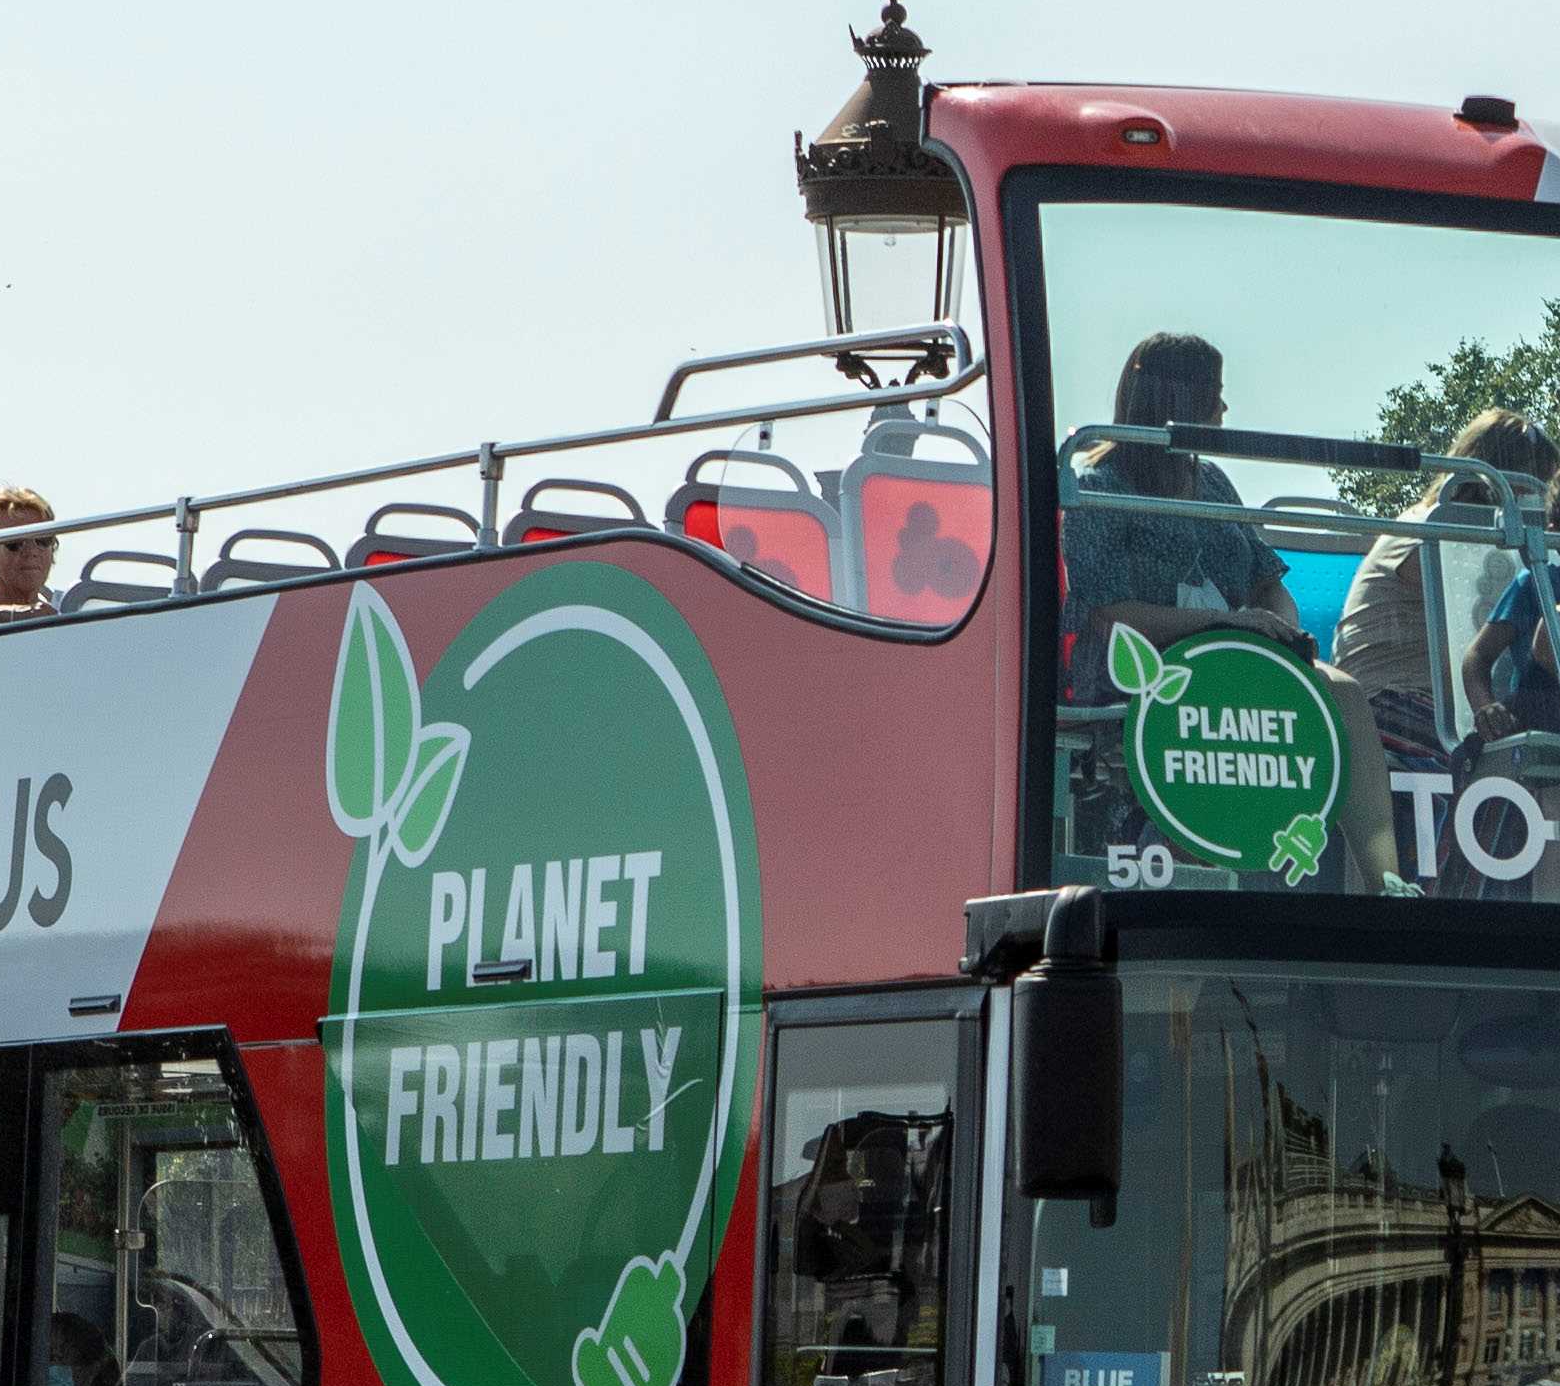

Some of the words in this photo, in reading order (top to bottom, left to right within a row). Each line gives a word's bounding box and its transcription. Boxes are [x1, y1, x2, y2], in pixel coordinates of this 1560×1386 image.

[1178, 705, 1298, 745] PLANET
[1163, 749, 1317, 790] FRIENDLY
[1107, 844, 1175, 889] 50
[425, 849, 663, 992] PLANET
[384, 1026, 682, 1167] FRIENDLY
